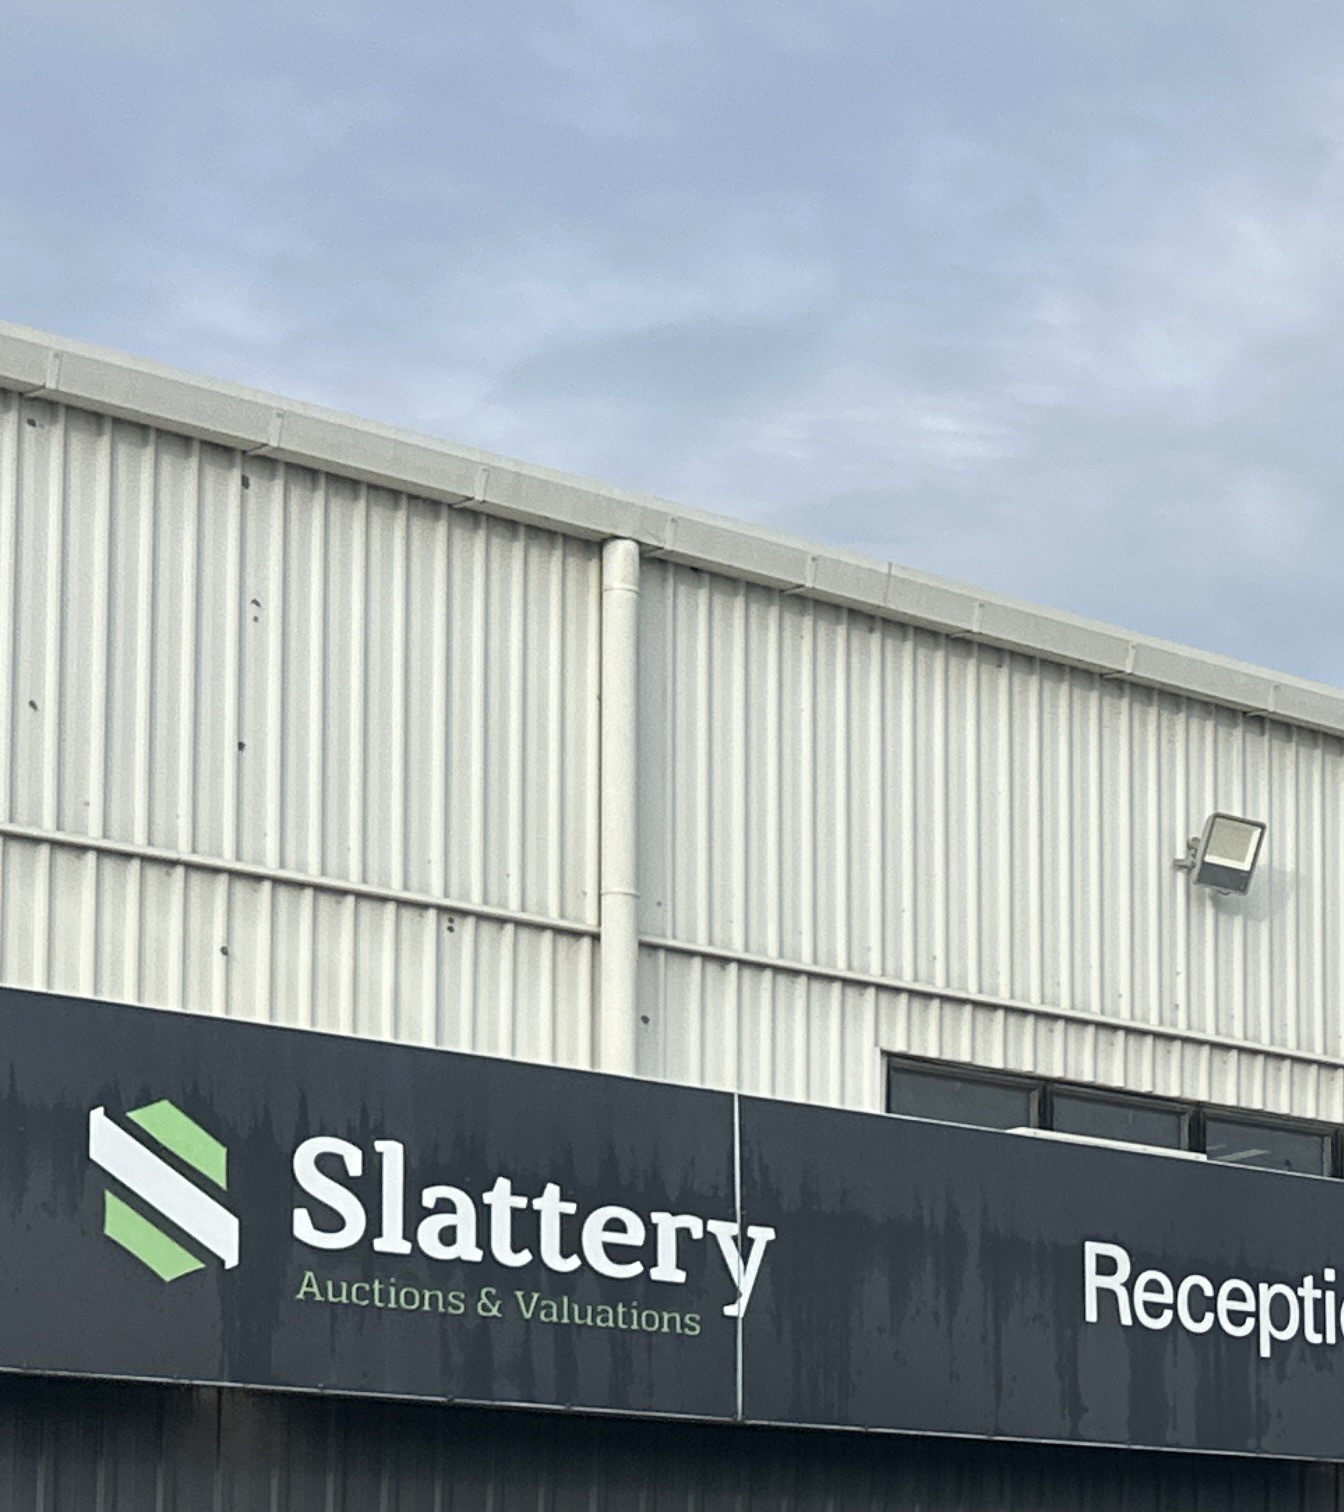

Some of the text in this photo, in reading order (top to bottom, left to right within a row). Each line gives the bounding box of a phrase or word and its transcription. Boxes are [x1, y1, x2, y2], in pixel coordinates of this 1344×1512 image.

[291, 1135, 777, 1318] Slattery
[294, 1270, 703, 1337] Auctions & Valuations
